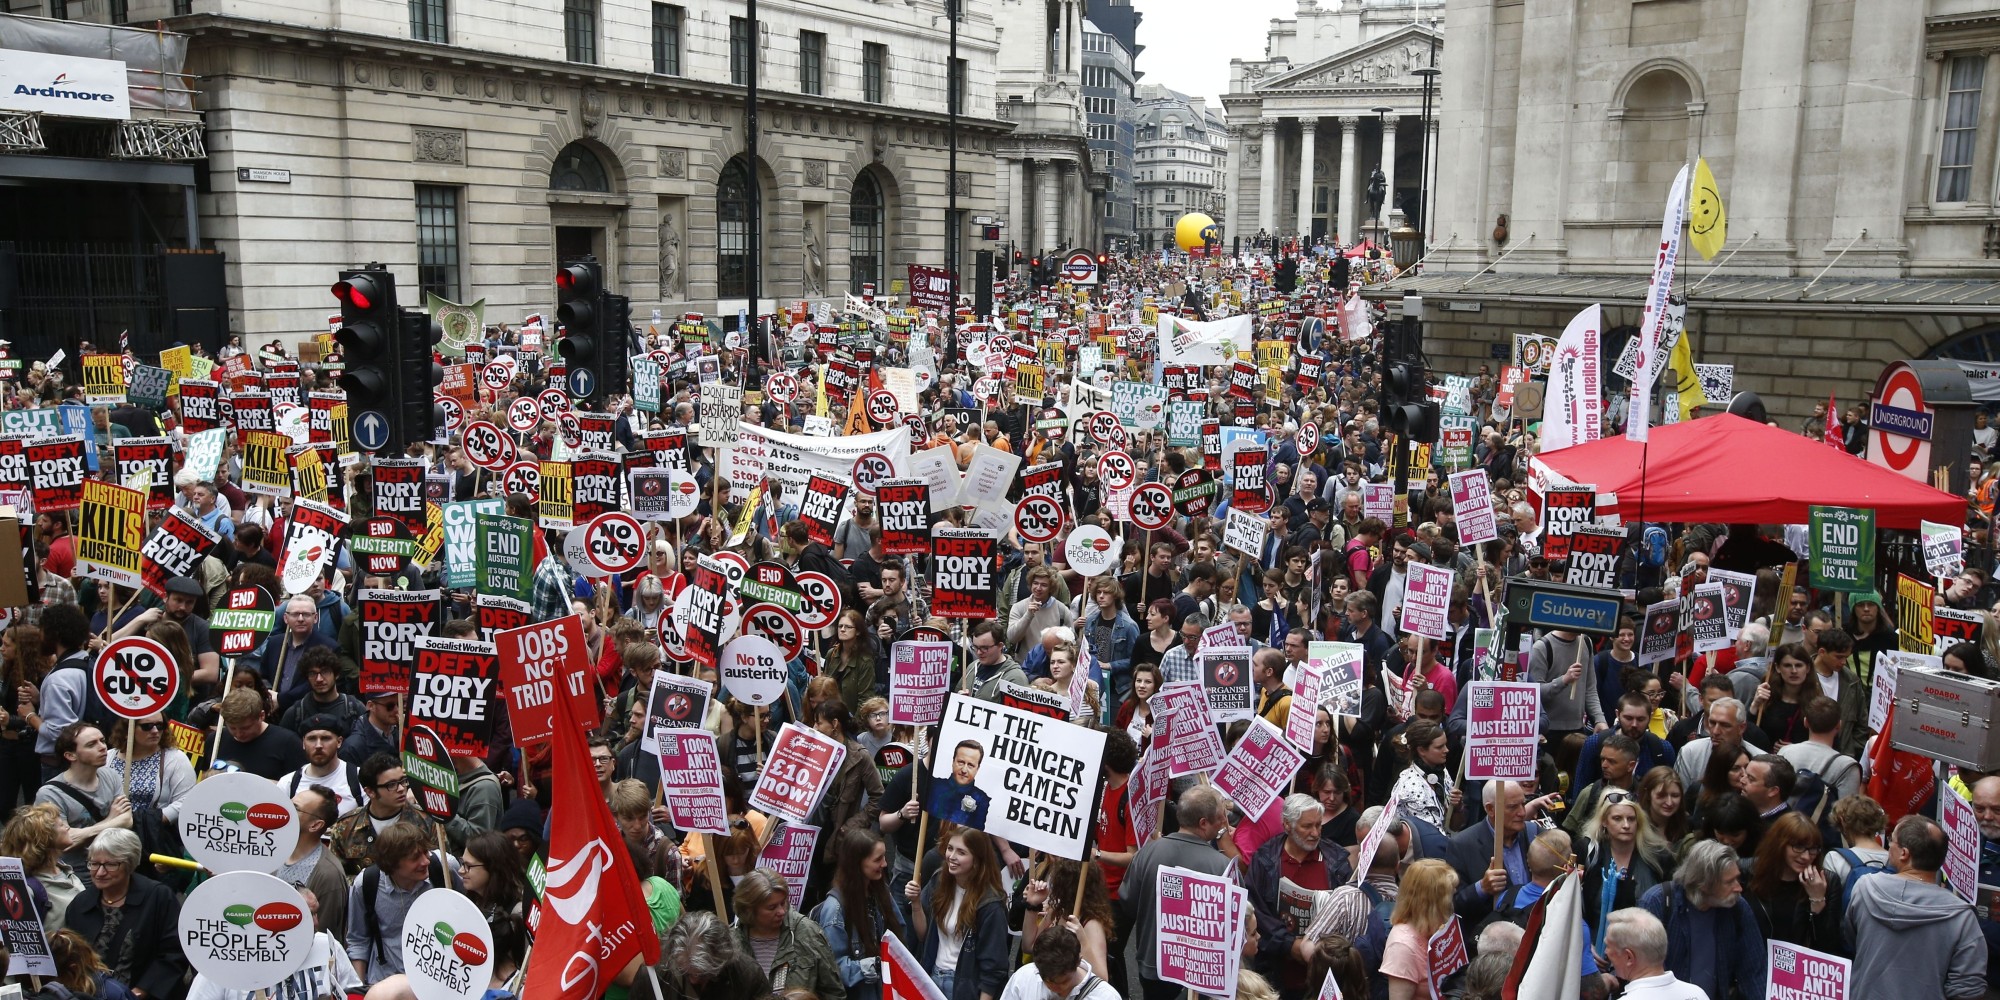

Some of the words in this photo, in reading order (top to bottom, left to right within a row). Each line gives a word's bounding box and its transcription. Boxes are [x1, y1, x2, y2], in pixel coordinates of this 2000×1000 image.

[14, 84, 114, 102] Ardmore
[83, 355, 121, 365] AUSTERITY
[634, 361, 657, 373] CUT
[86, 367, 123, 384] KILLS
[634, 372, 658, 384] WAR
[1017, 374, 1043, 389] KILLS
[87, 385, 124, 395] AUSTERITY
[635, 384, 658, 395] NOT
[728, 388, 739, 399] LET
[635, 395, 659, 404] WELFARE
[515, 403, 531, 412] NO
[702, 405, 739, 417] BASTARDS
[1176, 403, 1202, 413] CUT
[5, 412, 54, 425] CUT
[67, 409, 84, 427] NHS
[512, 411, 536, 422] CUTS
[701, 417, 718, 429] GET
[720, 418, 737, 430] YOU
[1235, 416, 1255, 425] Out!
[1440, 417, 1476, 427] CUT
[1875, 409, 1927, 434] UNDERGROUND
[1172, 425, 1200, 434] NOT
[1446, 439, 1469, 447] fracking
[30, 443, 79, 461] DEFY
[770, 449, 799, 461] Atos
[30, 456, 83, 475] TORY
[768, 463, 811, 474] Bedroom
[35, 471, 84, 489] RULE
[1183, 474, 1199, 485] END
[84, 482, 144, 511] AUSTERITY
[1174, 482, 1213, 502] AUSTERITY
[1026, 504, 1050, 515] NO
[1188, 498, 1205, 512] NOW
[81, 501, 142, 550] KILLS
[371, 522, 393, 535] END
[1020, 518, 1057, 529] CUTS
[600, 524, 632, 539] NO
[1242, 528, 1260, 543] THIS
[1823, 523, 1858, 545] END
[1931, 533, 1954, 543] Youth
[354, 537, 411, 554] AUSTERITY
[488, 532, 519, 555] END
[591, 541, 638, 557] CUTS
[937, 540, 992, 555] DEFY
[1573, 536, 1622, 553] DEFY
[1823, 545, 1857, 555] AUSTERITY
[1926, 543, 1950, 559] Fight
[80, 540, 140, 570] AUSTERITY
[488, 554, 519, 566] AUSTERITY
[1068, 550, 1104, 559] PEOPLE'S
[1571, 552, 1619, 571] TORY
[371, 557, 397, 570] NOW
[936, 556, 991, 573] TORY
[1833, 558, 1857, 567] CHEATING
[760, 569, 781, 582] END
[1567, 571, 1615, 588] RULE
[1823, 566, 1835, 577] US
[1837, 568, 1857, 580] ALL
[937, 573, 990, 590] RULE
[232, 591, 255, 607] END
[743, 581, 798, 607] AUSTERITY
[1542, 600, 1605, 624] Subway
[212, 612, 272, 628] AUSTERITY
[224, 632, 252, 648] NOW
[517, 625, 568, 663] JOBS
[115, 653, 155, 671] NO
[418, 652, 495, 677] DEFY
[736, 654, 755, 665] No
[759, 654, 773, 667] to
[1323, 651, 1353, 668] Youth
[725, 668, 787, 683] austerity
[104, 677, 168, 695] CUTS
[415, 673, 491, 699] TORY
[1924, 687, 1960, 700] ADDABOX
[1500, 691, 1534, 705] 100%
[412, 695, 486, 721] RULE
[1502, 706, 1534, 720] ANTI-
[955, 702, 997, 730] LET
[1003, 714, 1043, 744] THE
[1472, 720, 1535, 735] AUSTERITY
[1920, 724, 1956, 738] ADDABOX
[682, 739, 712, 753] 100%
[1472, 747, 1496, 756] TRADE
[1497, 746, 1531, 756] UNIONIST
[688, 754, 715, 769] ANTI-
[989, 735, 1086, 786] HUNGER
[1478, 757, 1492, 766] AND
[1494, 756, 1531, 766] SOCIALIST
[665, 770, 719, 784] AUSTERITY
[1494, 765, 1530, 775] COALITION
[760, 777, 812, 806] now!
[1004, 768, 1078, 809] GAMES
[195, 813, 224, 827] THE
[1006, 797, 1082, 839] BEGIN
[187, 824, 274, 845] PEOPLE'S
[205, 840, 276, 857] ASSEMBLY
[1189, 883, 1223, 901] 100%
[1191, 901, 1224, 920] ANTI-
[196, 919, 228, 933] THE
[1161, 914, 1224, 937] AUSTERITY
[188, 931, 286, 949] PEOPLE'S
[416, 924, 434, 945] THE
[209, 948, 289, 961] ASSEMBLY
[455, 939, 486, 958] AUSTERITY
[406, 934, 471, 982] PEOPLE'S
[416, 958, 471, 995] ASSEMBLY
[1802, 960, 1842, 981] 100%
[1803, 977, 1842, 996] ANTI-
